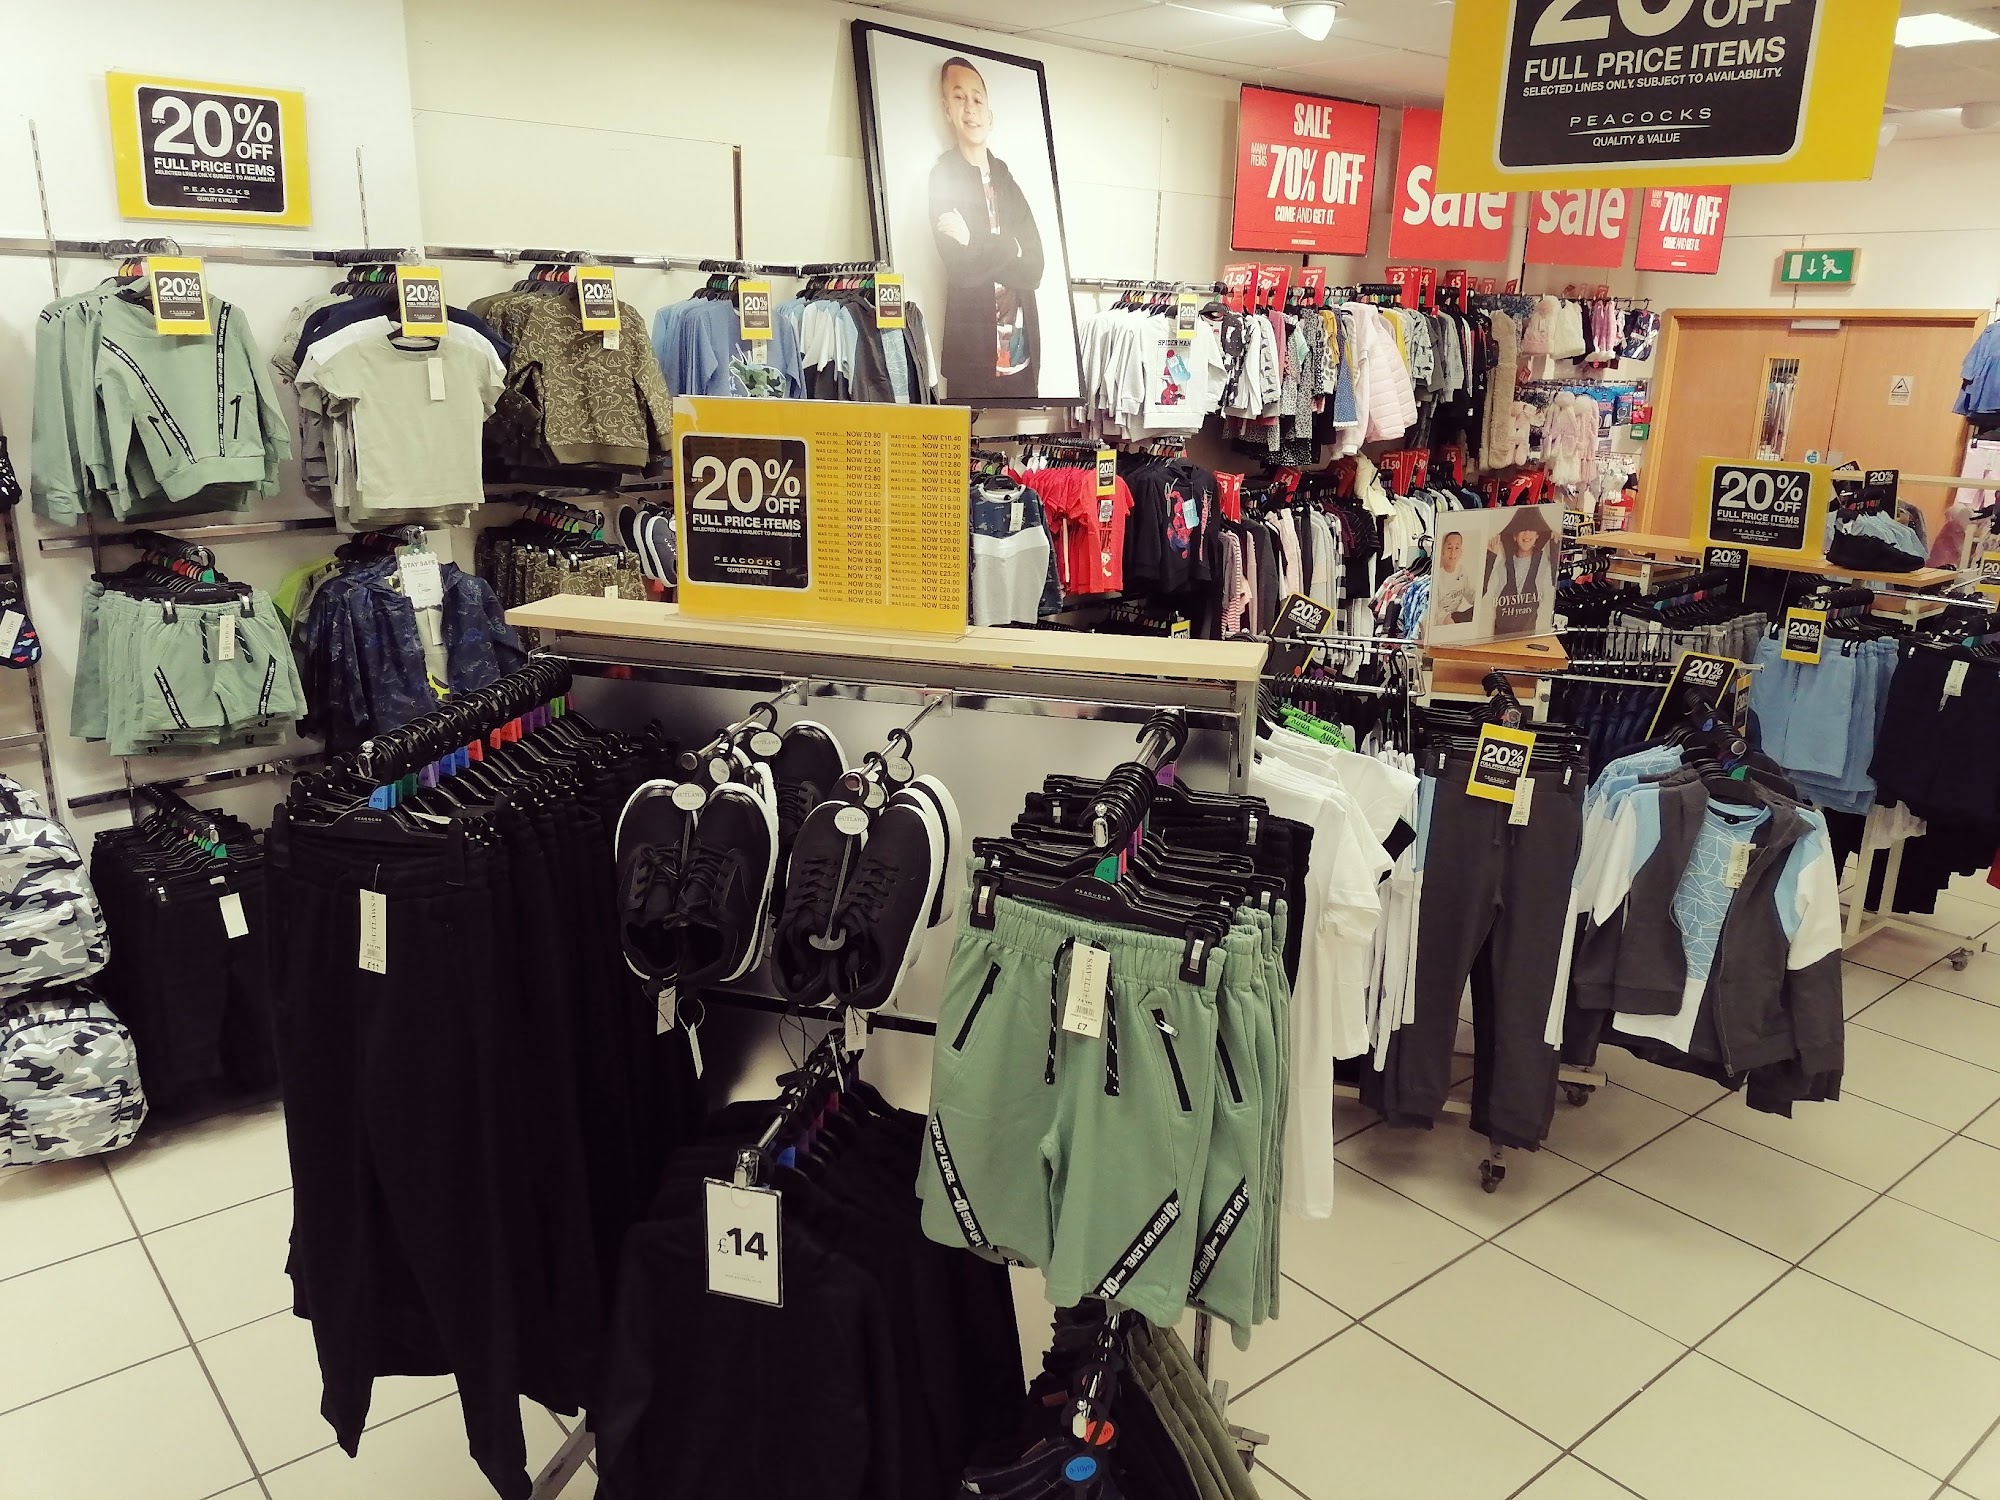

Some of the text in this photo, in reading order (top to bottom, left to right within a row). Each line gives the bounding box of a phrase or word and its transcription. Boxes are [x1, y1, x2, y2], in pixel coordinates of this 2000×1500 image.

[1524, 35, 1786, 83] FULL PRICE ITEMS
[1522, 84, 1573, 97] SELECTED
[1574, 81, 1604, 93] LINES
[1636, 74, 1687, 89] SUBJECT
[1688, 73, 1704, 84] TO
[151, 96, 273, 158] 20%
[1293, 102, 1332, 140] SALE
[1569, 107, 1713, 129] PEACOCKS
[1250, 142, 1268, 156] MANY
[1592, 132, 1681, 148] QUALITY & VALUE
[235, 142, 274, 160] OFF
[154, 157, 275, 176] FULL PRICE ITEMS
[1266, 144, 1366, 205] 70% OFF
[183, 185, 251, 195] PEACOCKS
[1274, 205, 1297, 222] COME
[1297, 207, 1313, 223] AND
[1312, 208, 1327, 224] GET
[1659, 190, 1722, 236] 70% OFF
[158, 277, 200, 297] 20%
[1304, 274, 1319, 288] £7
[1392, 271, 1405, 285] £2
[1450, 276, 1462, 288] £5
[405, 284, 440, 302] 20%
[584, 283, 613, 299] 20%
[744, 296, 767, 311] 20%
[1157, 339, 1178, 347] SPIDER
[1380, 458, 1400, 470] £1.50
[691, 455, 800, 513] 20%
[1870, 471, 1894, 482] 20%
[1718, 470, 1804, 511] 20%
[765, 497, 801, 515] OFF
[1773, 500, 1802, 513] OFF
[692, 513, 801, 531] FULL PRICE ITEMS
[1563, 513, 1581, 526] 20%
[1716, 509, 1740, 519] FULL
[1741, 511, 1769, 522] PRICE
[1770, 514, 1800, 525] ITEMS
[402, 559, 436, 569] STAY SAFE
[713, 555, 781, 567] PEACOCKS
[1710, 548, 1741, 563] 20%
[1492, 591, 1543, 608] BOYSWEAR
[1290, 599, 1323, 621] 20%
[1515, 606, 1533, 618] years
[1789, 621, 1820, 637] 20%
[1685, 659, 1724, 679] 20%
[1481, 743, 1525, 765] 20%
[1508, 760, 1522, 769] OFF
[1077, 1022, 1088, 1031] £7
[935, 1141, 946, 1154] UP
[940, 1155, 957, 1186] LEVEL
[1233, 1194, 1246, 1213] UP
[960, 1211, 976, 1232] STEP
[1153, 1212, 1170, 1235] STEP
[1215, 1207, 1238, 1237] LEVEL
[717, 1227, 769, 1262] £14
[969, 1230, 982, 1243] UP
[1144, 1230, 1157, 1248] UP
[1123, 1243, 1148, 1270] LEVEL
[1199, 1256, 1212, 1273] STEP
[1192, 1269, 1204, 1285] UP
